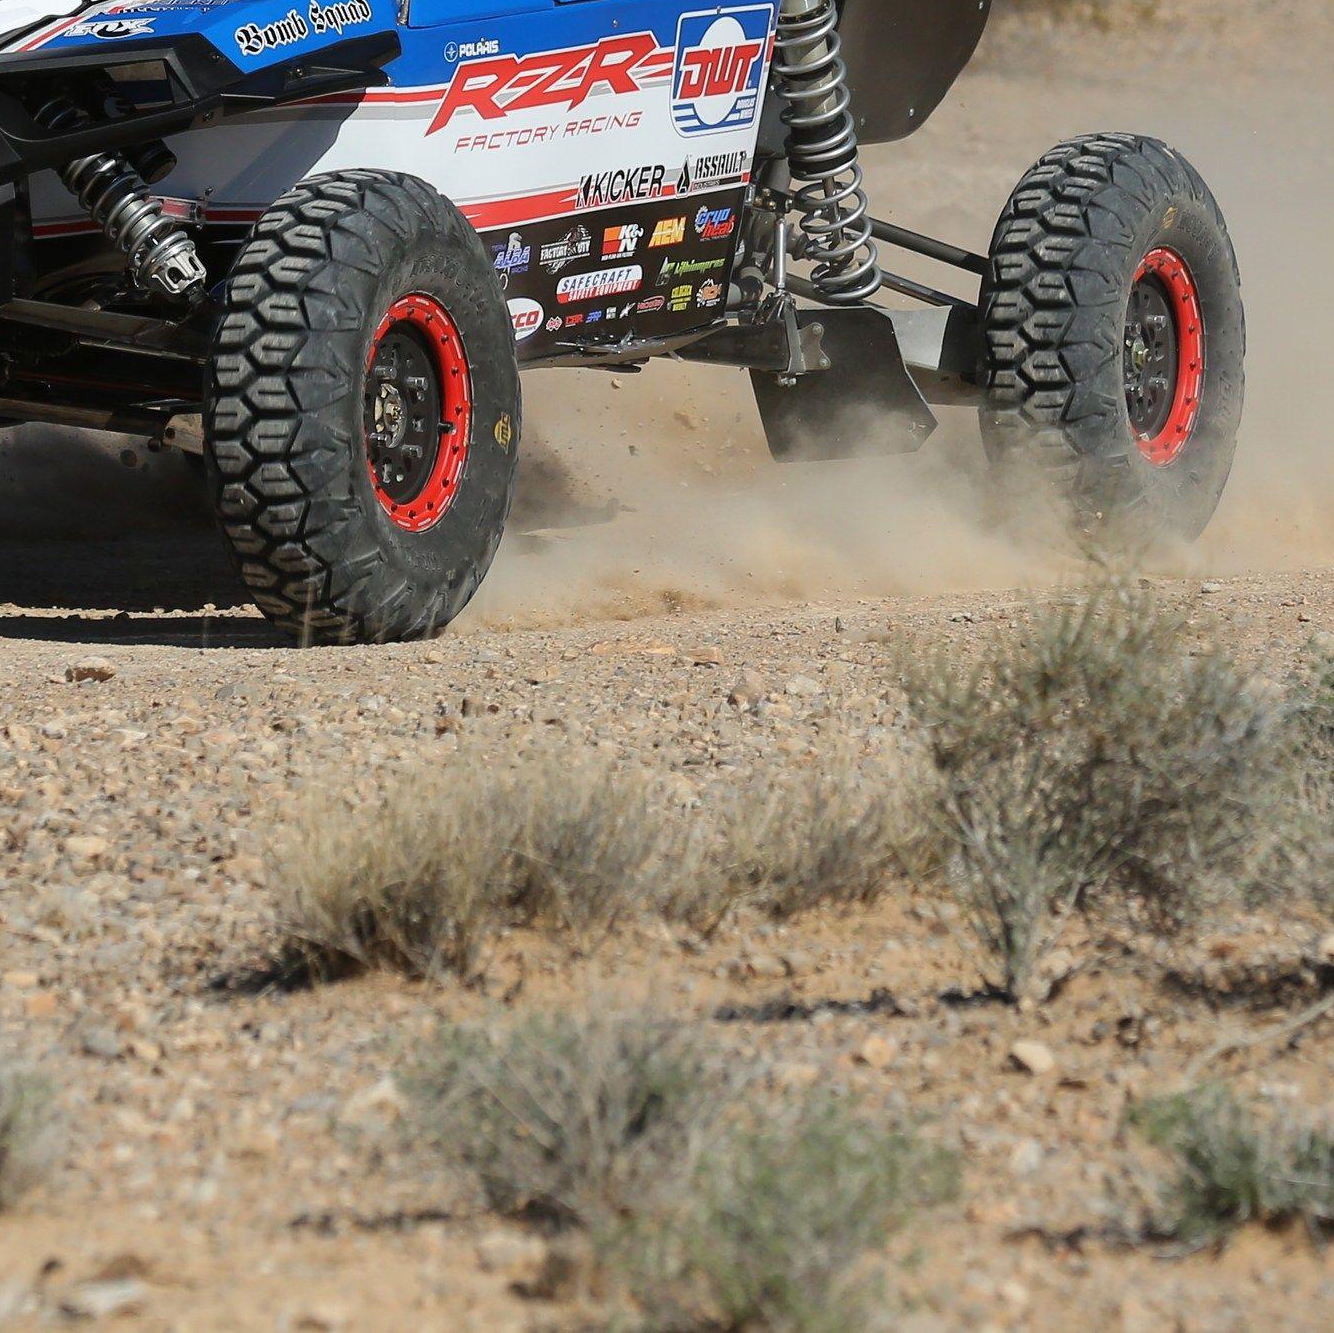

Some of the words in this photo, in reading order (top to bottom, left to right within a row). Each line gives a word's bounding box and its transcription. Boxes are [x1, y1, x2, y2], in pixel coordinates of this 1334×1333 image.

[235, 10, 308, 56] Bomb
[459, 39, 499, 57] POLARIS
[425, 32, 659, 137] RZR
[454, 124, 559, 153] FACTORY
[562, 111, 643, 139] RACING
[588, 165, 665, 205] KICKER
[561, 268, 632, 293] SAFECRAFT
